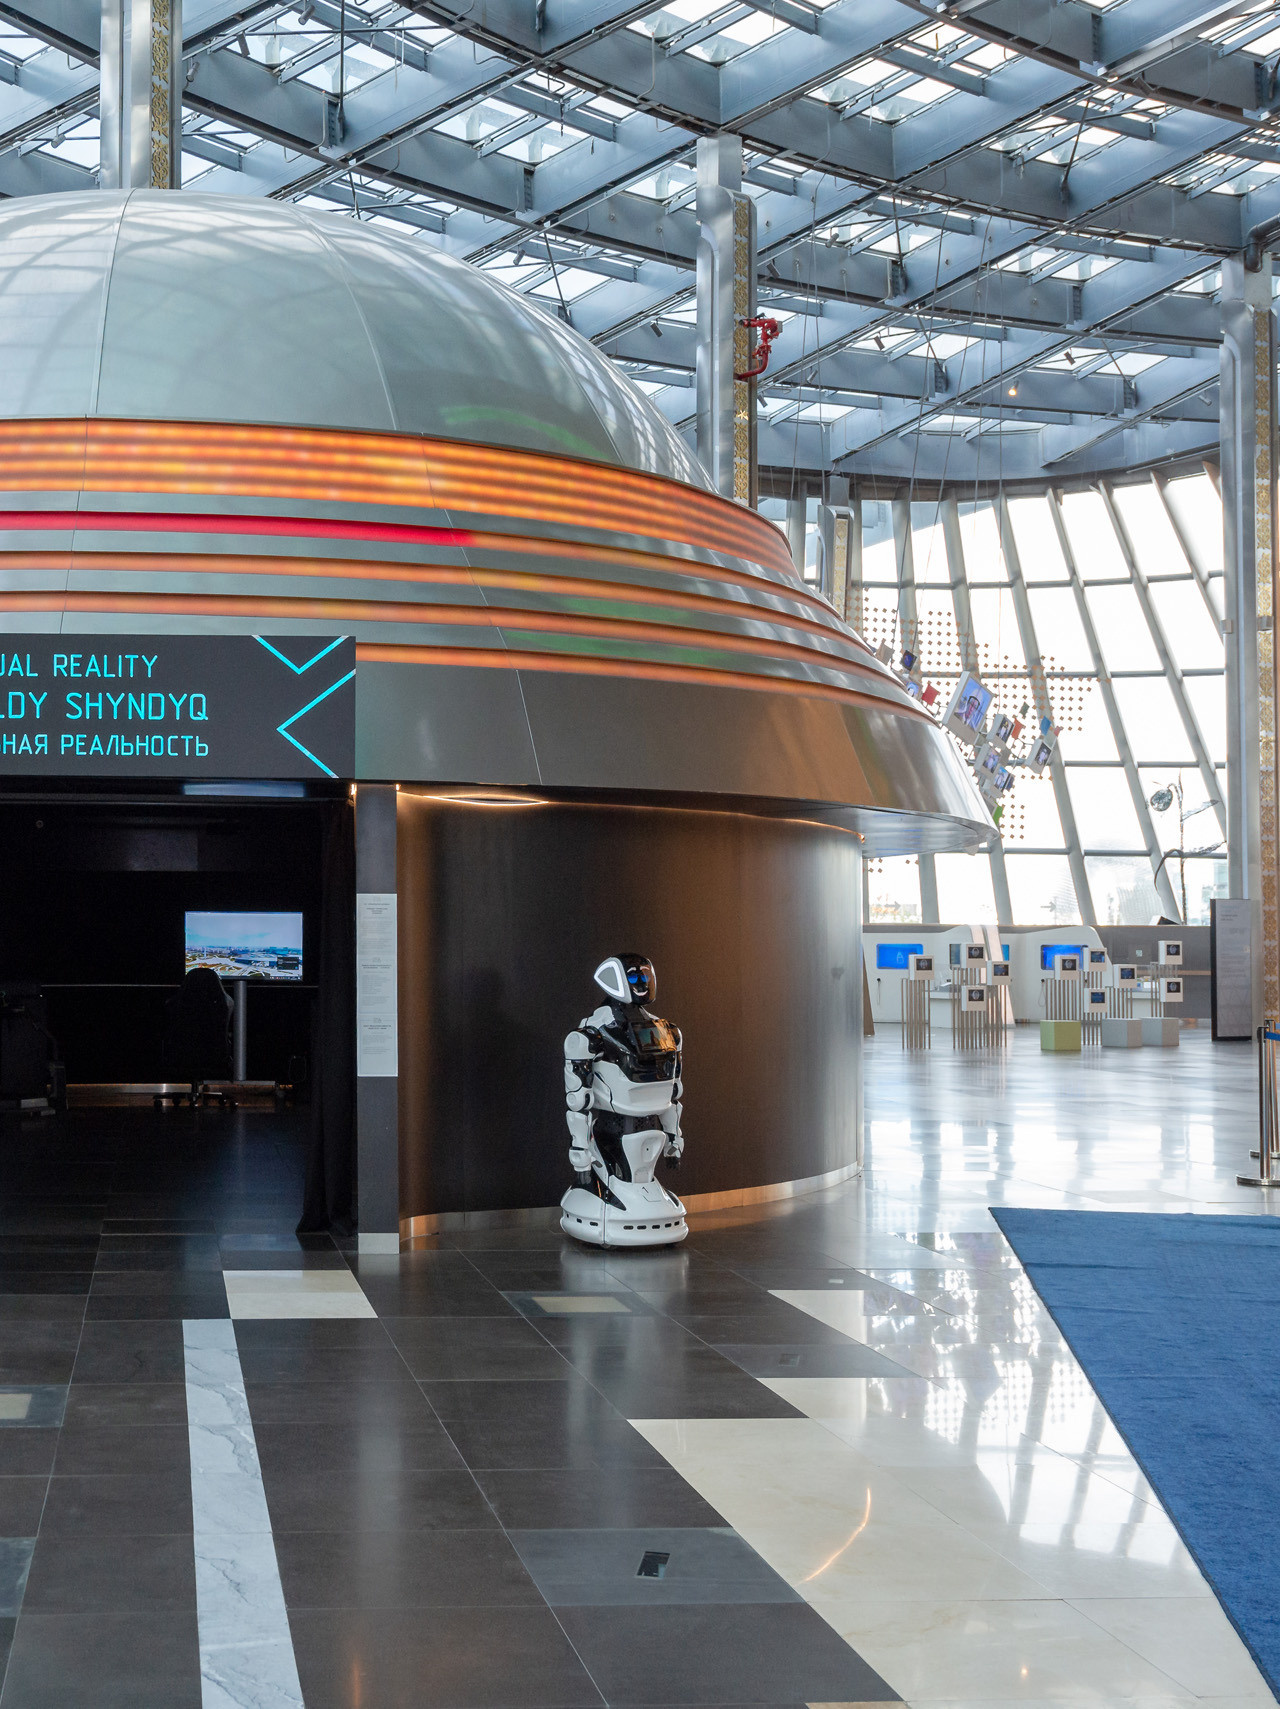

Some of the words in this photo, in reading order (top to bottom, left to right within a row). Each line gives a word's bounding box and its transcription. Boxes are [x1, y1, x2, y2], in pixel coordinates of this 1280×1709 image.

[53, 654, 158, 679] REALITY
[66, 692, 209, 721] SHYNDYQ
[60, 734, 209, 757] РЕАЛЬНОСТЬ
